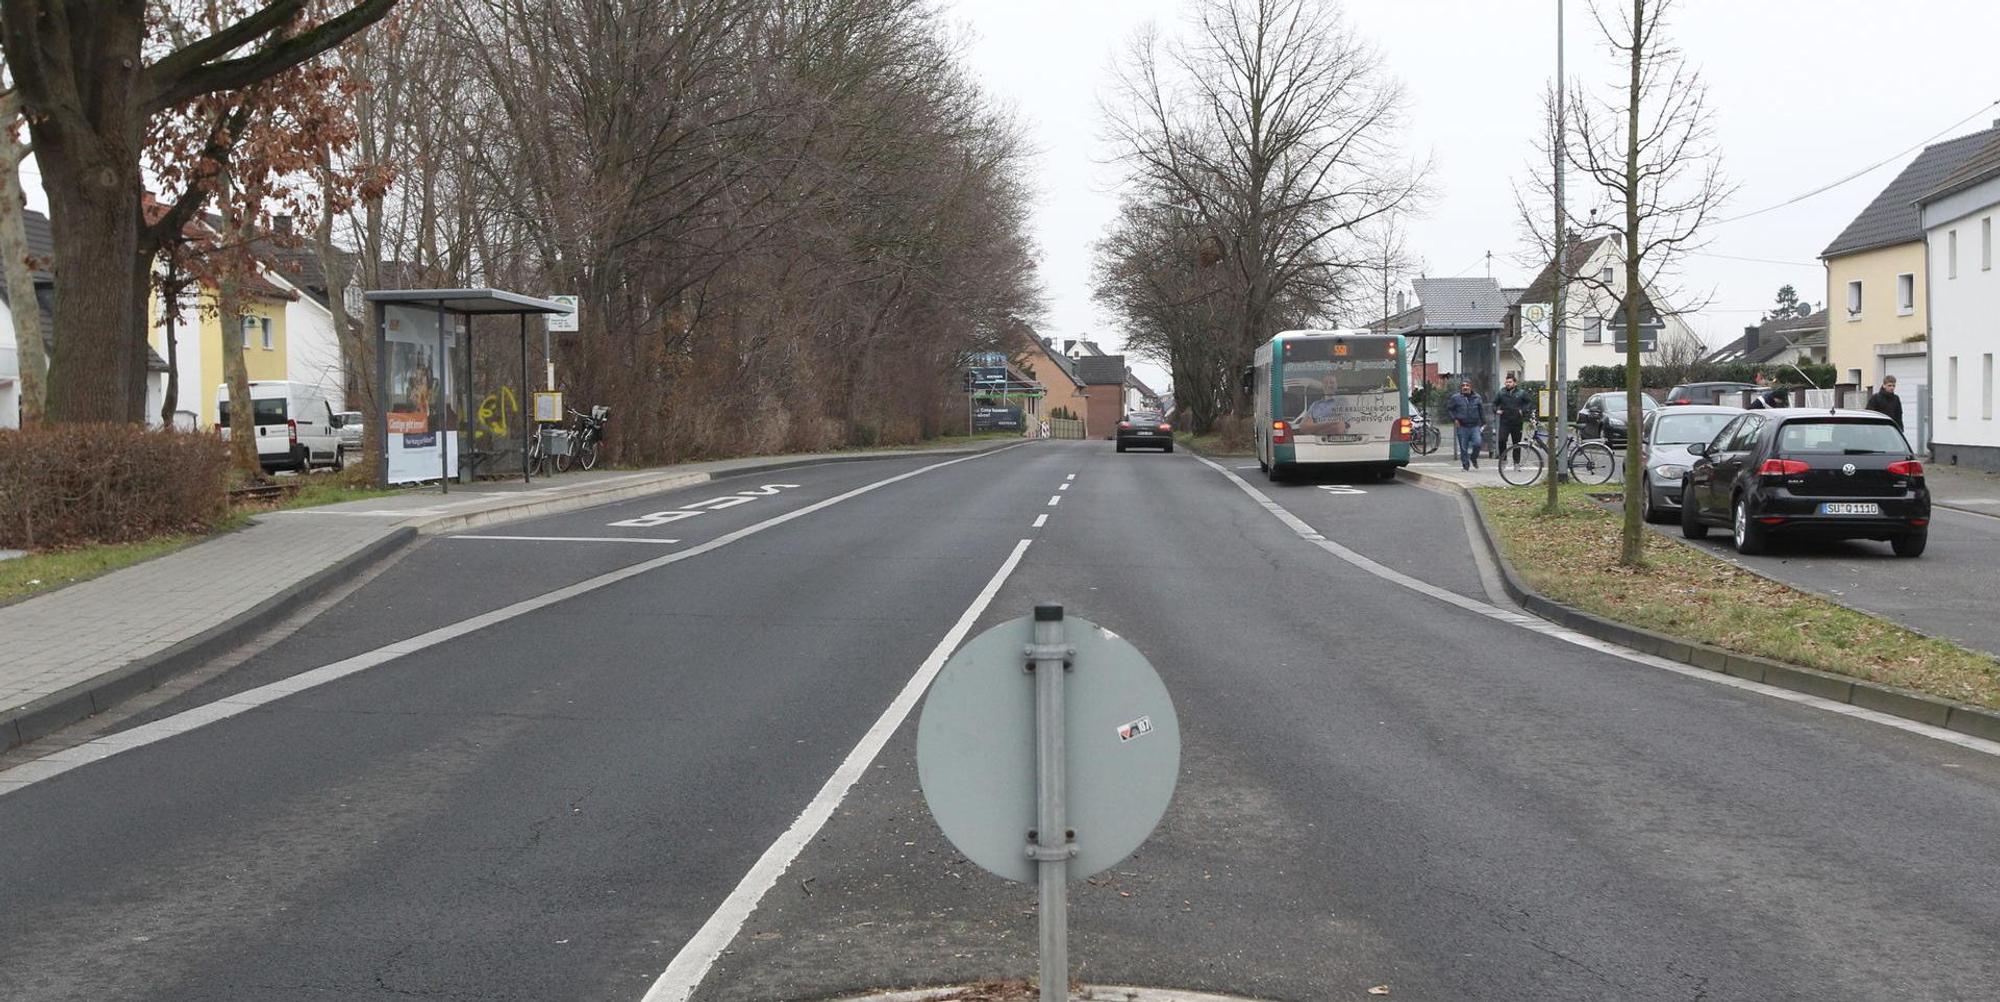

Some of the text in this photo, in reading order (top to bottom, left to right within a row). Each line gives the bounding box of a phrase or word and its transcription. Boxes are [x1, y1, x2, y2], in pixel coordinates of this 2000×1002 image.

[606, 484, 801, 527] BUS
[1828, 503, 1840, 513] SU
[1854, 503, 1877, 513] 1110
